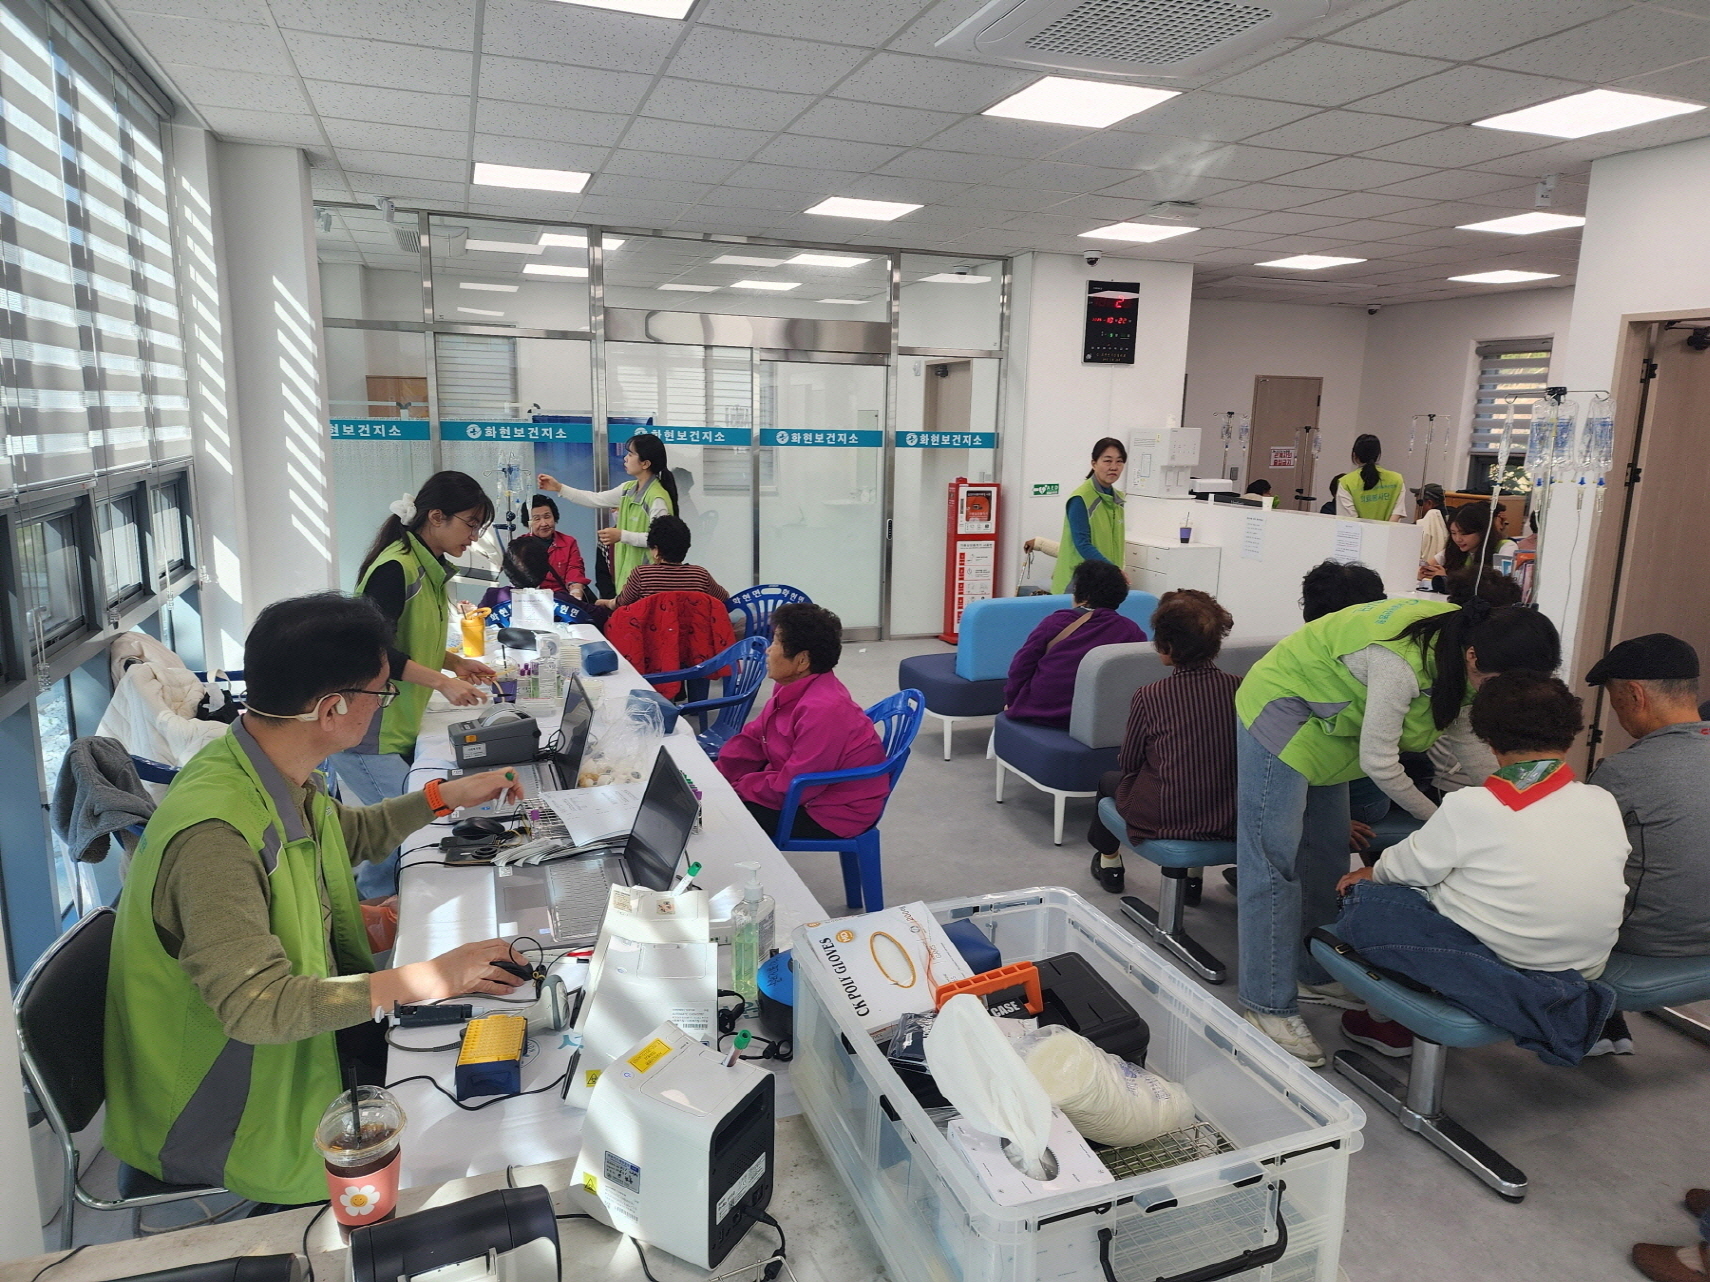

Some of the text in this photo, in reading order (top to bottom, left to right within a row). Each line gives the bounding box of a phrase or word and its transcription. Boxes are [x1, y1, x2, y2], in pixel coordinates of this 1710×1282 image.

[484, 425, 567, 439] 화현보건지소
[790, 432, 859, 444] 화현보건지소
[919, 433, 982, 446] 화현보건지소
[732, 589, 761, 604] 화현면
[819, 937, 847, 974] GLOVES
[838, 975, 862, 1000] POLY
[851, 998, 870, 1017] CK
[990, 1001, 1021, 1017] CASE
